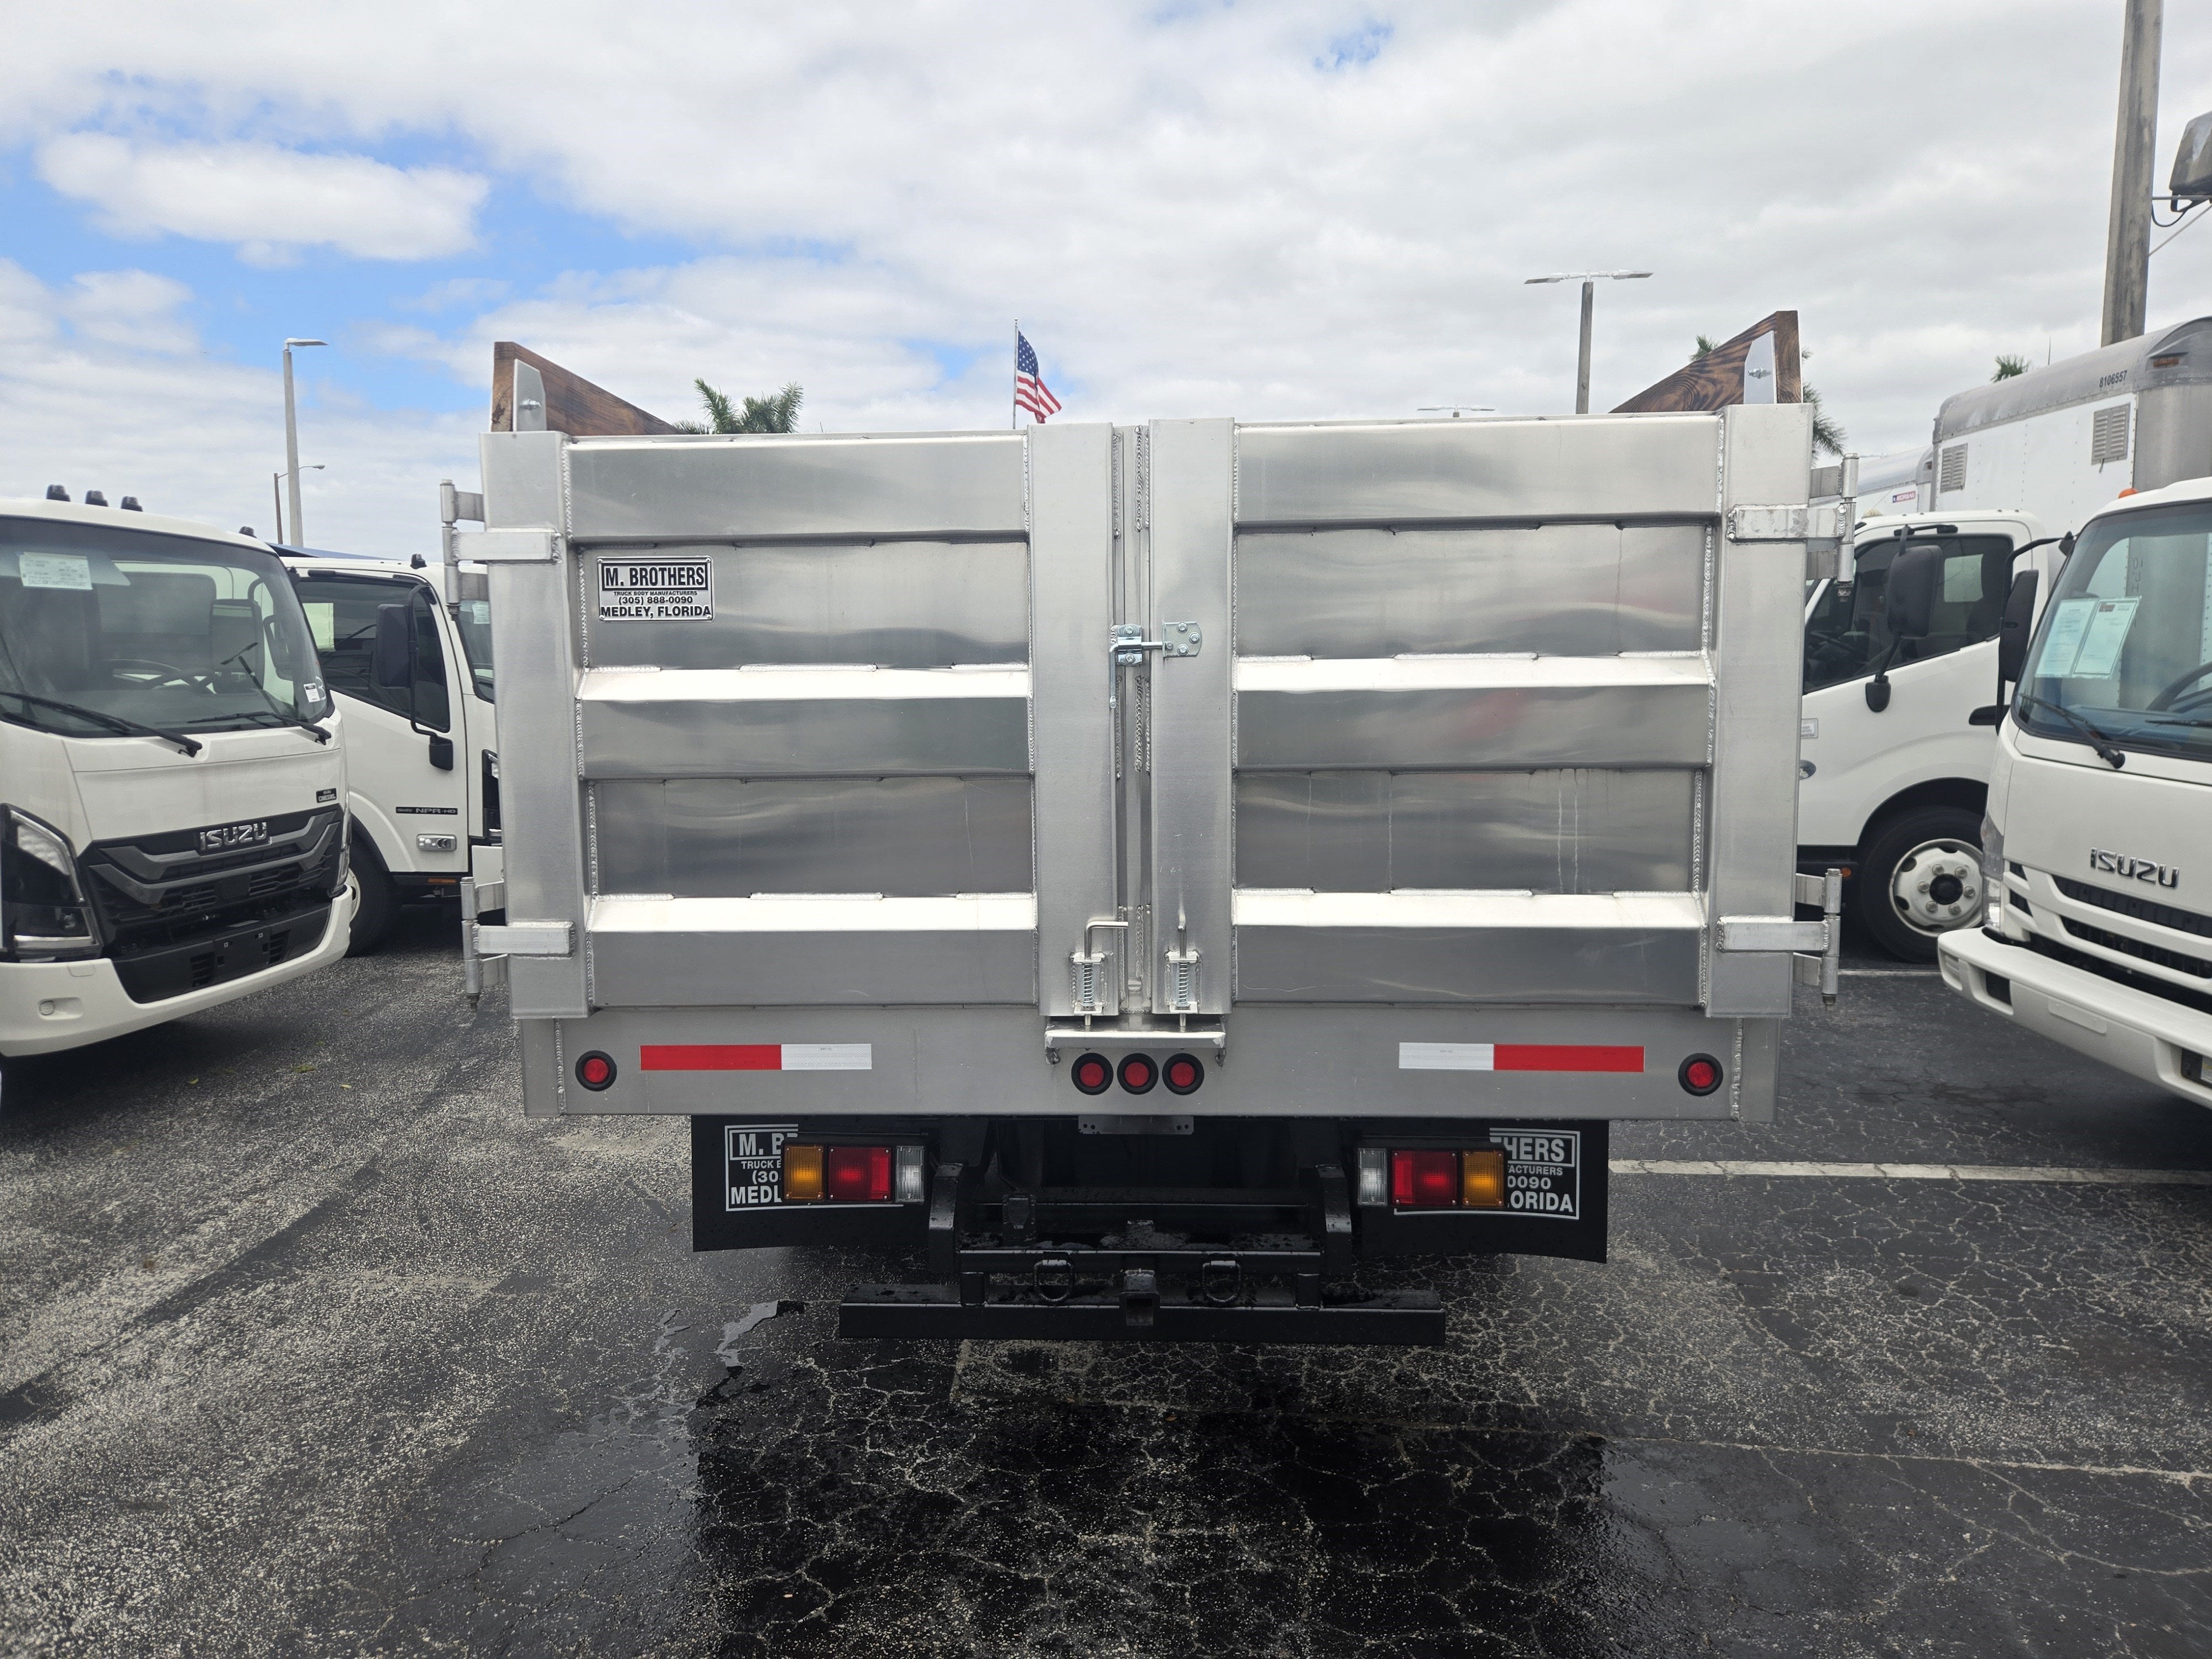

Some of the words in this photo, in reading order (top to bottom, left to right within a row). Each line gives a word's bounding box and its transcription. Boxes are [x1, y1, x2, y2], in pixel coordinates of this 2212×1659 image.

[2099, 369, 2128, 388] 8106557
[606, 567, 624, 586] M.
[629, 567, 705, 586] BROTHERS
[619, 596, 644, 606] (305)
[601, 606, 654, 619] MEDLEY,
[658, 606, 711, 617] FLORIDA
[200, 822, 267, 851] ISUZU
[2090, 847, 2180, 889] ISUZU
[739, 1133, 764, 1156] M.
[1490, 1136, 1564, 1162] HERS
[741, 1160, 774, 1170] TRUCK
[1507, 1165, 1563, 1176] ACTURERS
[752, 1170, 781, 1185] (30
[1507, 1190, 1573, 1212] ORIDA
